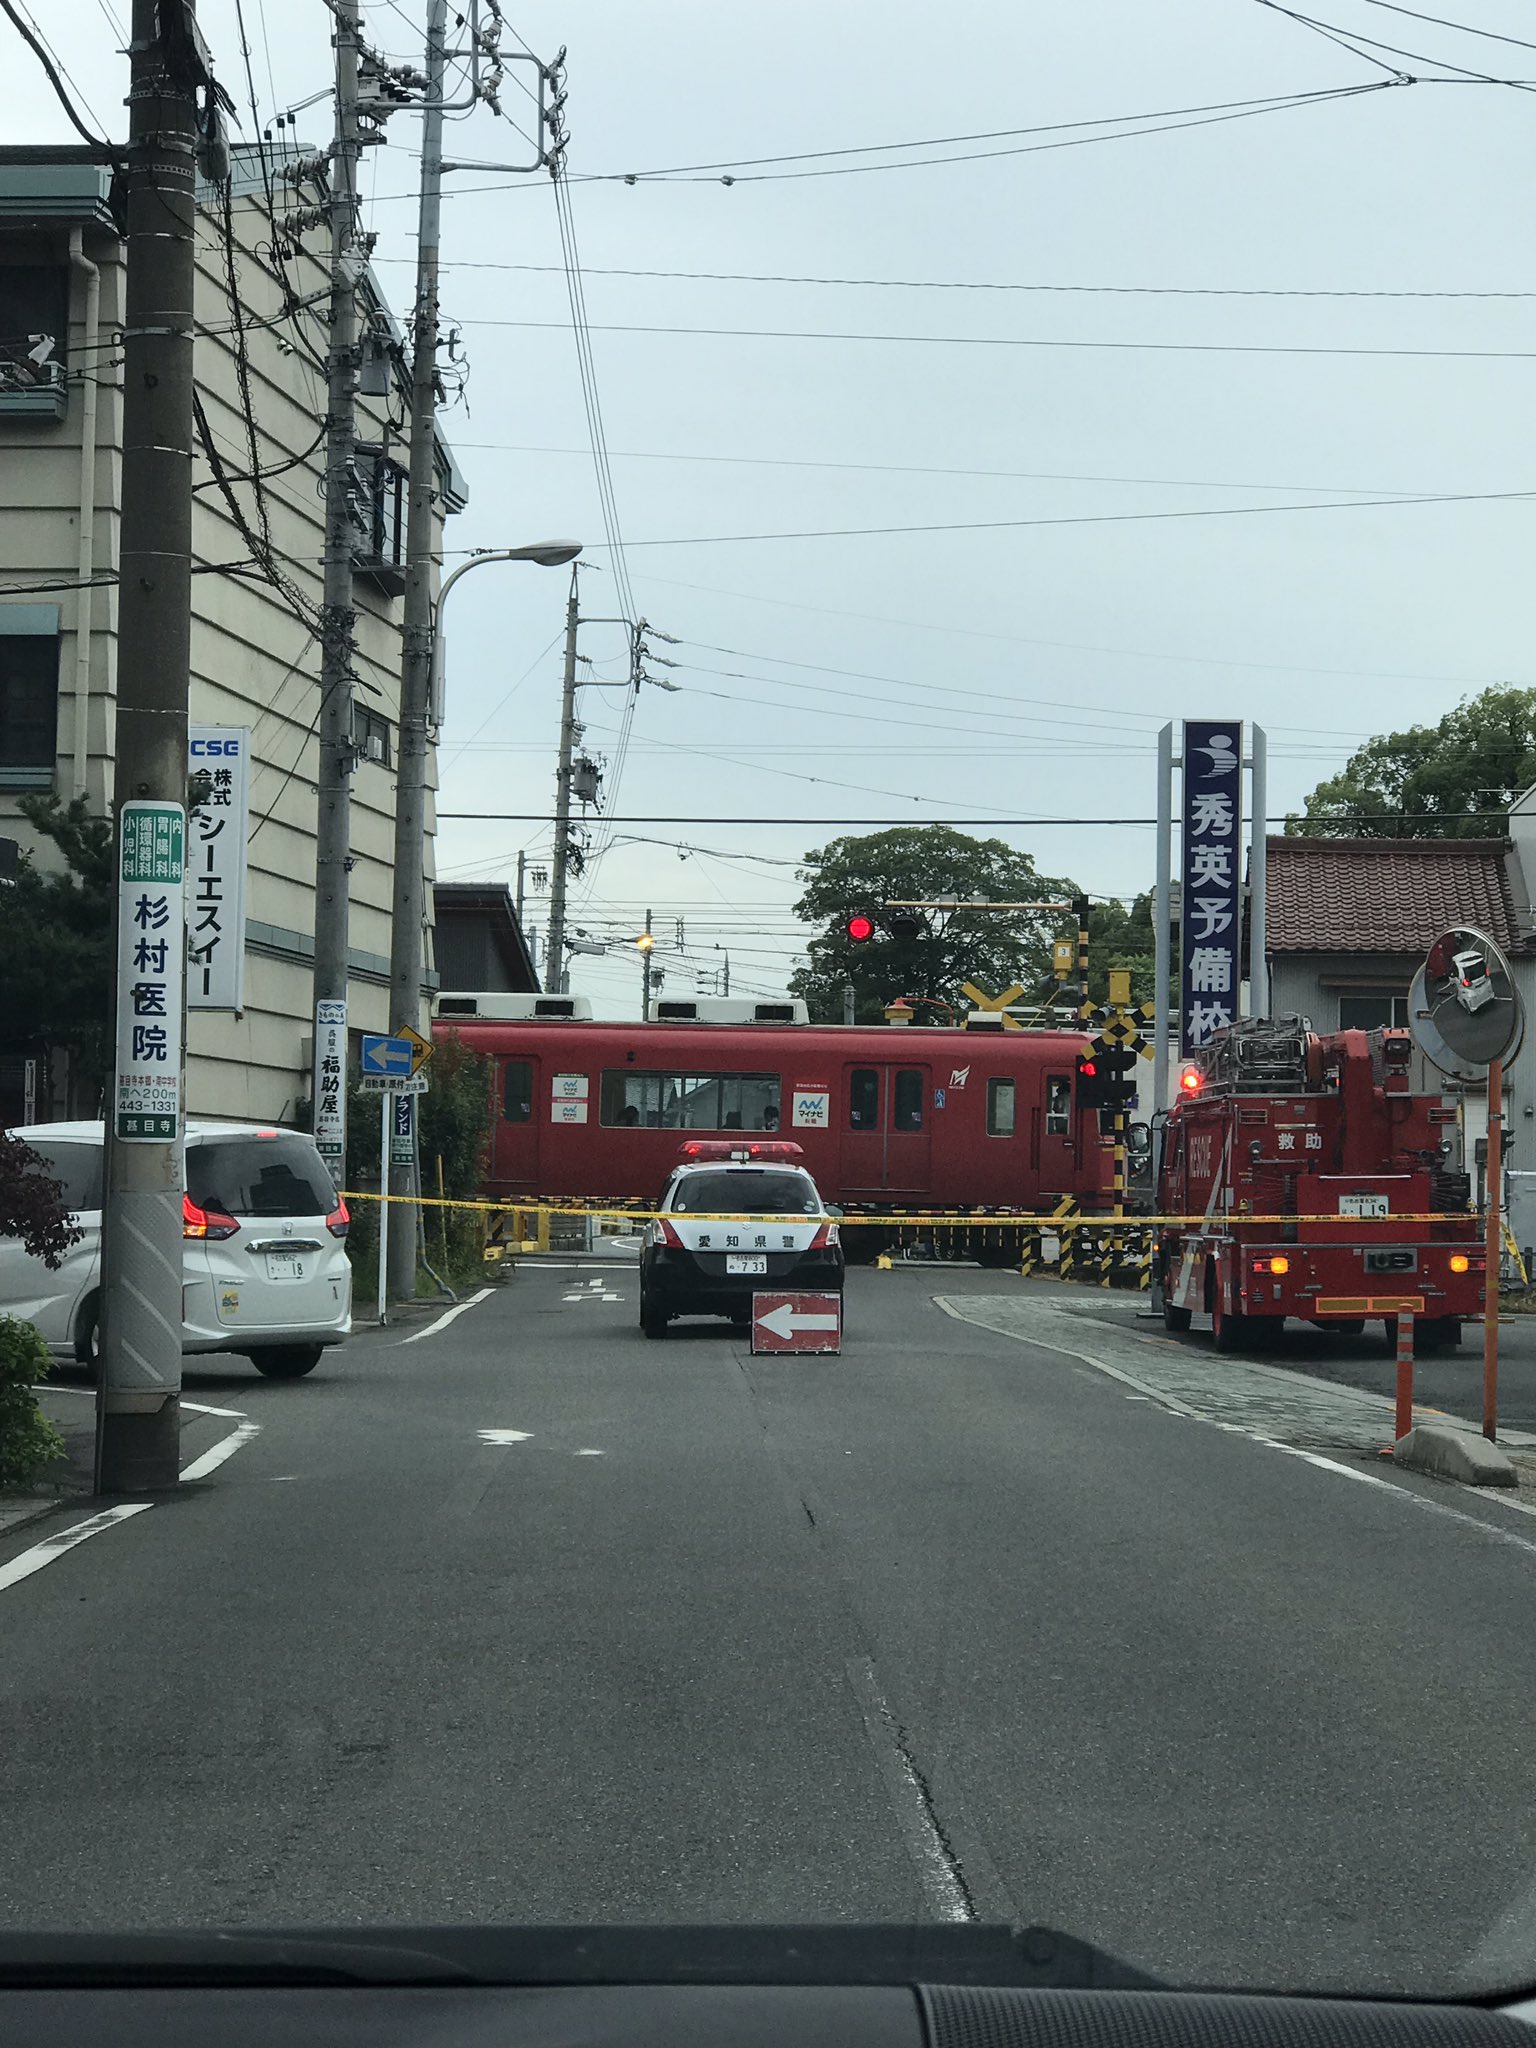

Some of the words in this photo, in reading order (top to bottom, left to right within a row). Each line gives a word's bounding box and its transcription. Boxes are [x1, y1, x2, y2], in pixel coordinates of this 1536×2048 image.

[214, 769, 232, 806] 株式
[123, 816, 136, 877] 小児科
[139, 816, 153, 877] 循環器科
[156, 816, 168, 877] 胃腸科
[171, 818, 182, 878] 内科
[194, 815, 226, 995] シーエスイー
[1188, 793, 1234, 1046] 秀英予備校
[132, 893, 170, 1061] 杉村医院
[119, 1100, 176, 1112] 443-1331
[320, 1054, 341, 1114] 福助屋
[799, 1110, 823, 1118] マイナビ
[126, 1120, 170, 1132] 甚目寺
[1278, 1133, 1322, 1150] 救助
[698, 1235, 795, 1248] 愛知県警
